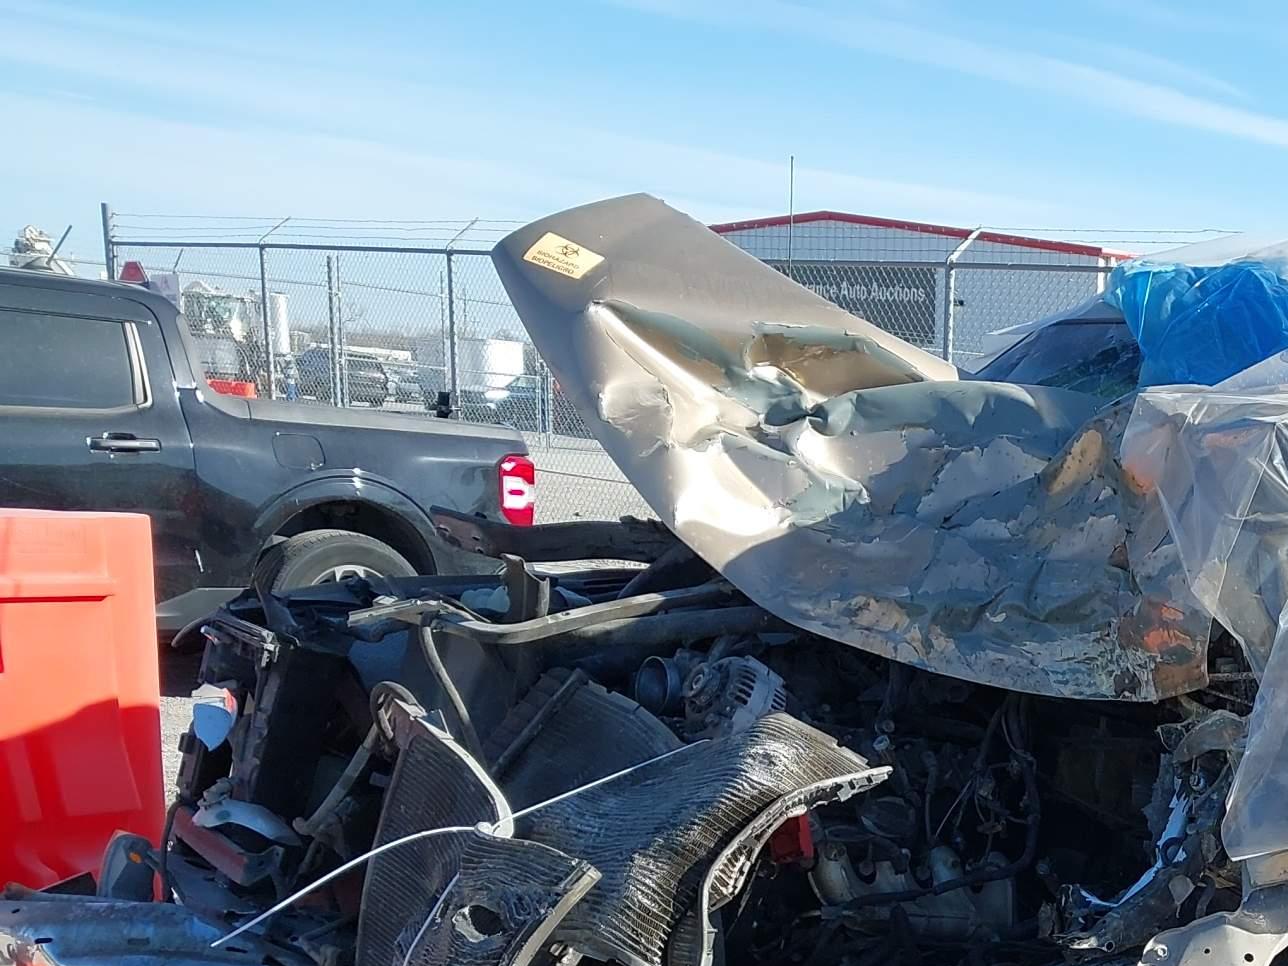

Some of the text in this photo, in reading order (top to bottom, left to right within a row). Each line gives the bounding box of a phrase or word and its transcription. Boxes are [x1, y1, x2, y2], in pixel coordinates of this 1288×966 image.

[531, 255, 574, 274] BIOPELIGRO
[537, 250, 579, 269] BIOHAZARD
[840, 281, 867, 300] Auto
[868, 281, 926, 301] Auctions
